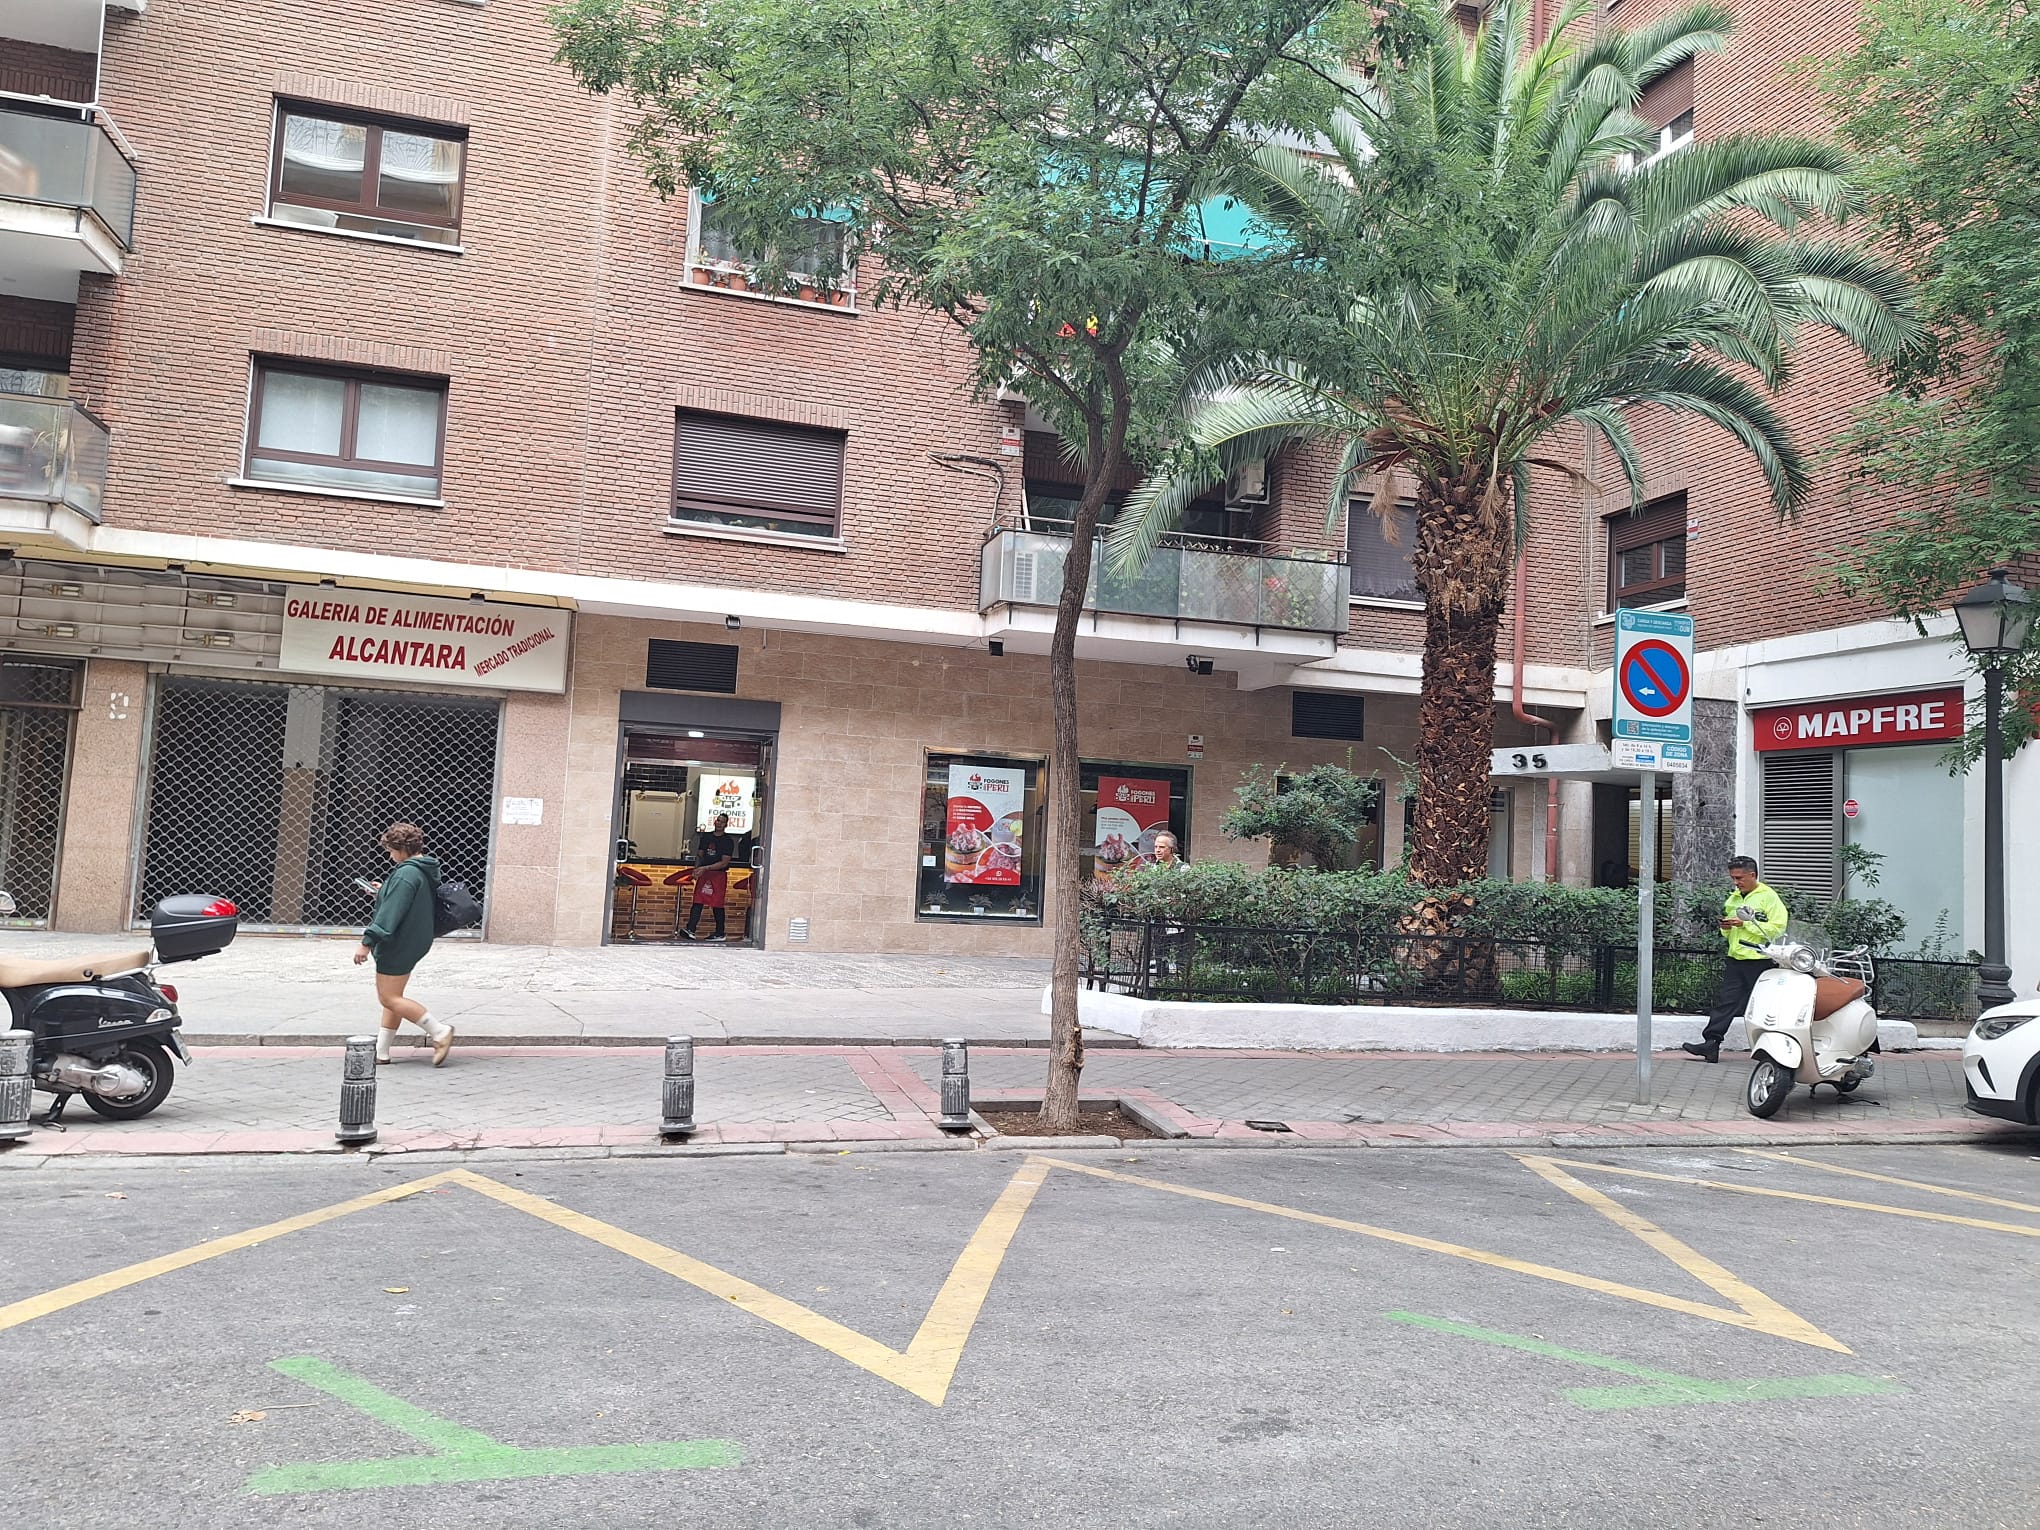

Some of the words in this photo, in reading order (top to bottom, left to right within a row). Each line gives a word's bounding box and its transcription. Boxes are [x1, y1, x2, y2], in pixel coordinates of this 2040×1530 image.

[287, 599, 360, 623] GALERIA
[364, 606, 389, 626] DE
[391, 608, 515, 637] ALIMENTACIÓN
[328, 635, 466, 671] ALCANTARA
[473, 650, 510, 678] MERCADO
[507, 626, 556, 661] TRADICIONAL
[1798, 701, 1945, 739] MAPFRE
[1511, 753, 1548, 769] 35
[1130, 789, 1156, 797] FOGONES
